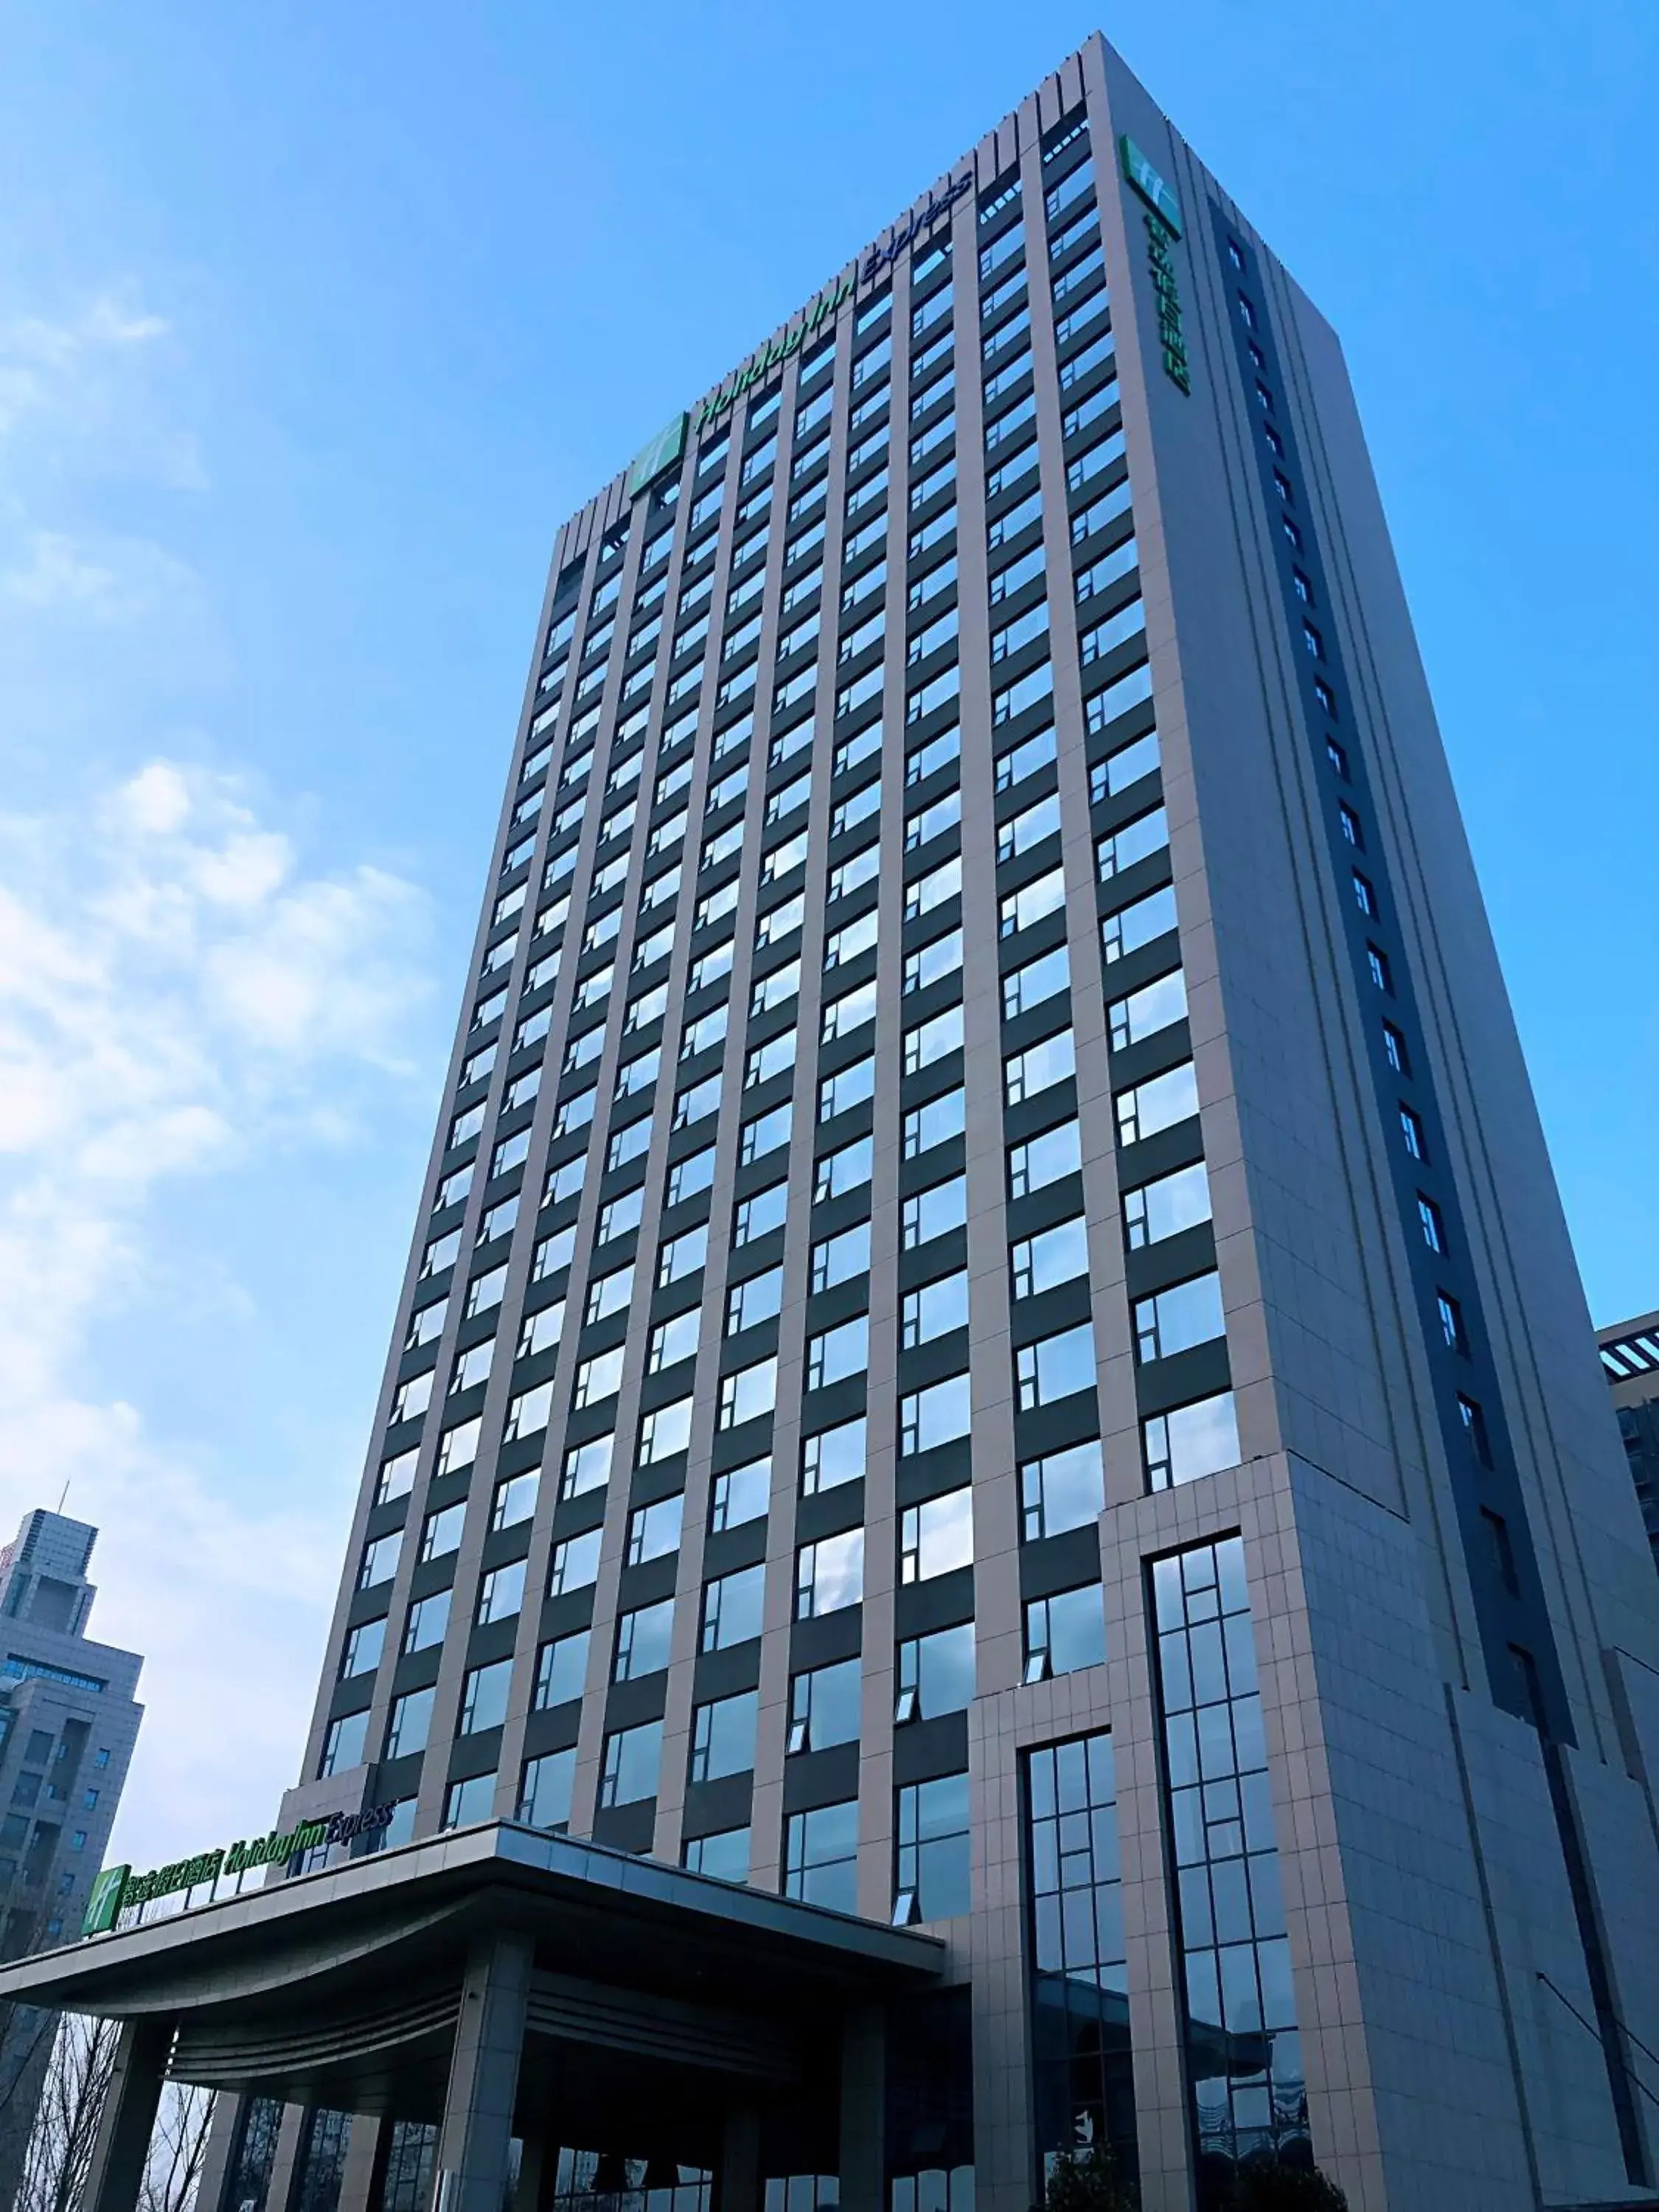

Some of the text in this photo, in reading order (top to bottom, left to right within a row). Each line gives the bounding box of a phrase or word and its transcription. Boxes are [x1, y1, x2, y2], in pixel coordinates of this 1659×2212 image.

[696, 170, 973, 435] Holiday Inn Express
[122, 1804, 394, 1907] 智选假日酒店 Holiday Inn Express
